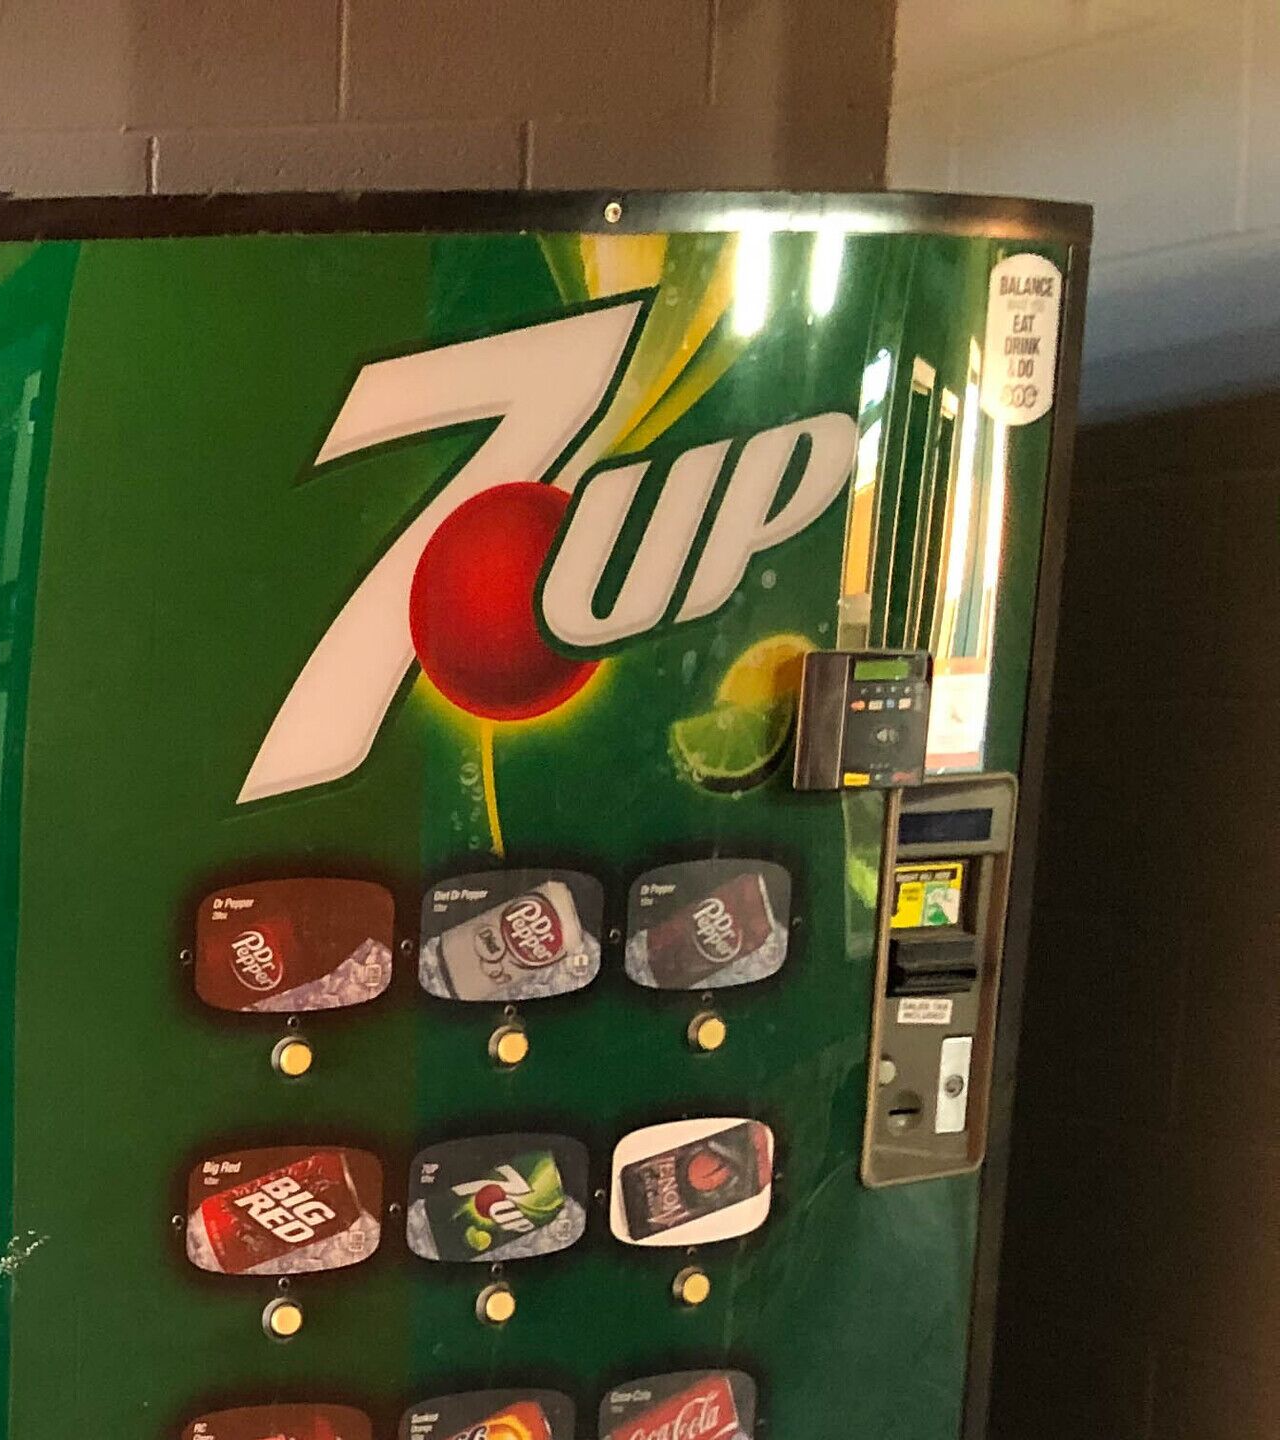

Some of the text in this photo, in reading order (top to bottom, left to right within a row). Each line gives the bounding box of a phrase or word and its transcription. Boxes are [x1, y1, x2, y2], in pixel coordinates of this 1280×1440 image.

[999, 275, 1055, 297] BALANCE
[1013, 314, 1035, 333] EAT
[1004, 337, 1041, 355] DRINK
[1017, 359, 1034, 379] DO
[451, 890, 461, 900] Dr
[461, 889, 488, 901] Pepper
[650, 883, 676, 896] Pepper
[213, 898, 255, 911] Dr Pepper
[505, 900, 551, 960] Pepper
[534, 915, 556, 943] Dr
[692, 898, 732, 955] Pepper
[719, 917, 735, 940] Dr
[231, 930, 274, 987] Pepper
[257, 944, 276, 973] Dr
[202, 1161, 241, 1176] Big Red
[260, 1176, 336, 1226] BIG
[233, 1191, 315, 1243] RED
[193, 1423, 207, 1433] RC
